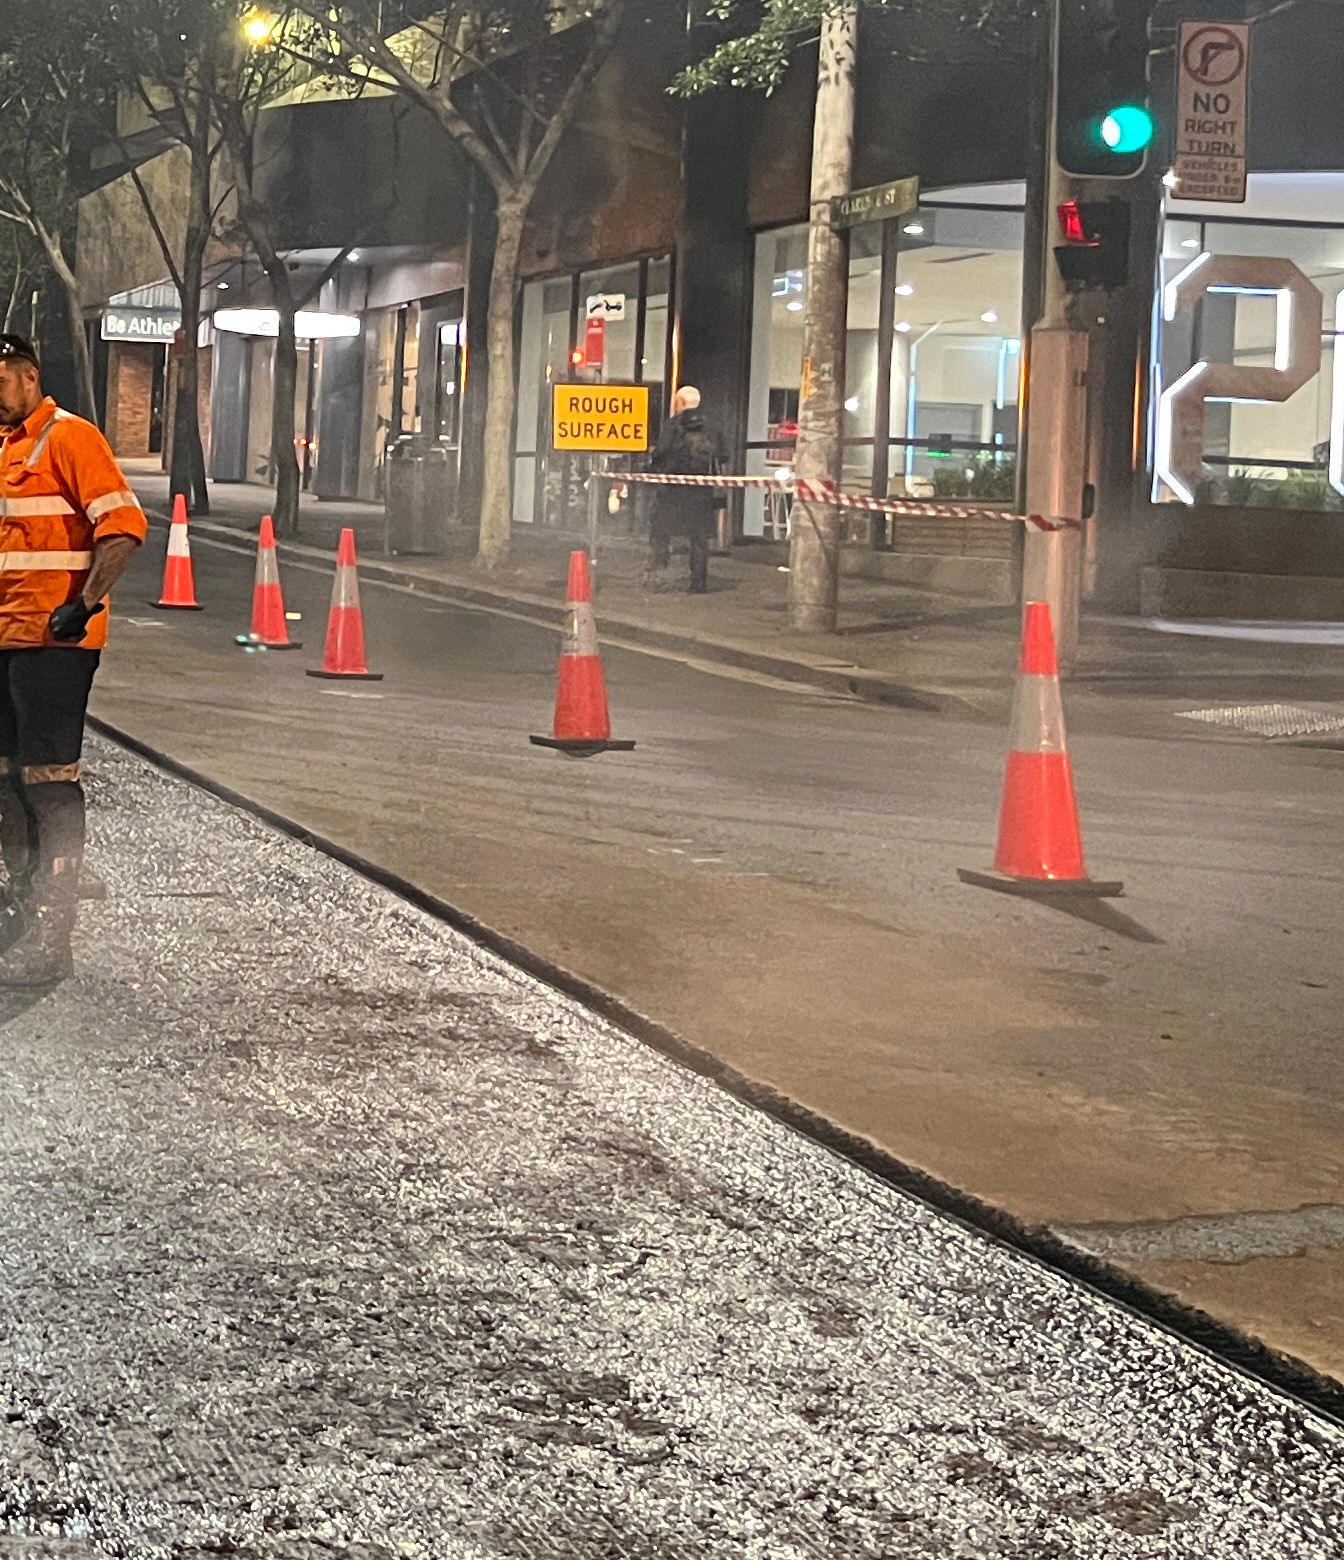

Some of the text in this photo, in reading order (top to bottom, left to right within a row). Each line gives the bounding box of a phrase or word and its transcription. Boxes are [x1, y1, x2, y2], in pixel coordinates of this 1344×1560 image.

[1193, 92, 1230, 114] NO
[1184, 118, 1237, 135] RIGHT
[1187, 139, 1235, 155] TURN
[106, 314, 126, 334] Be
[569, 397, 633, 414] ROUGH
[558, 422, 644, 440] SURFACE
